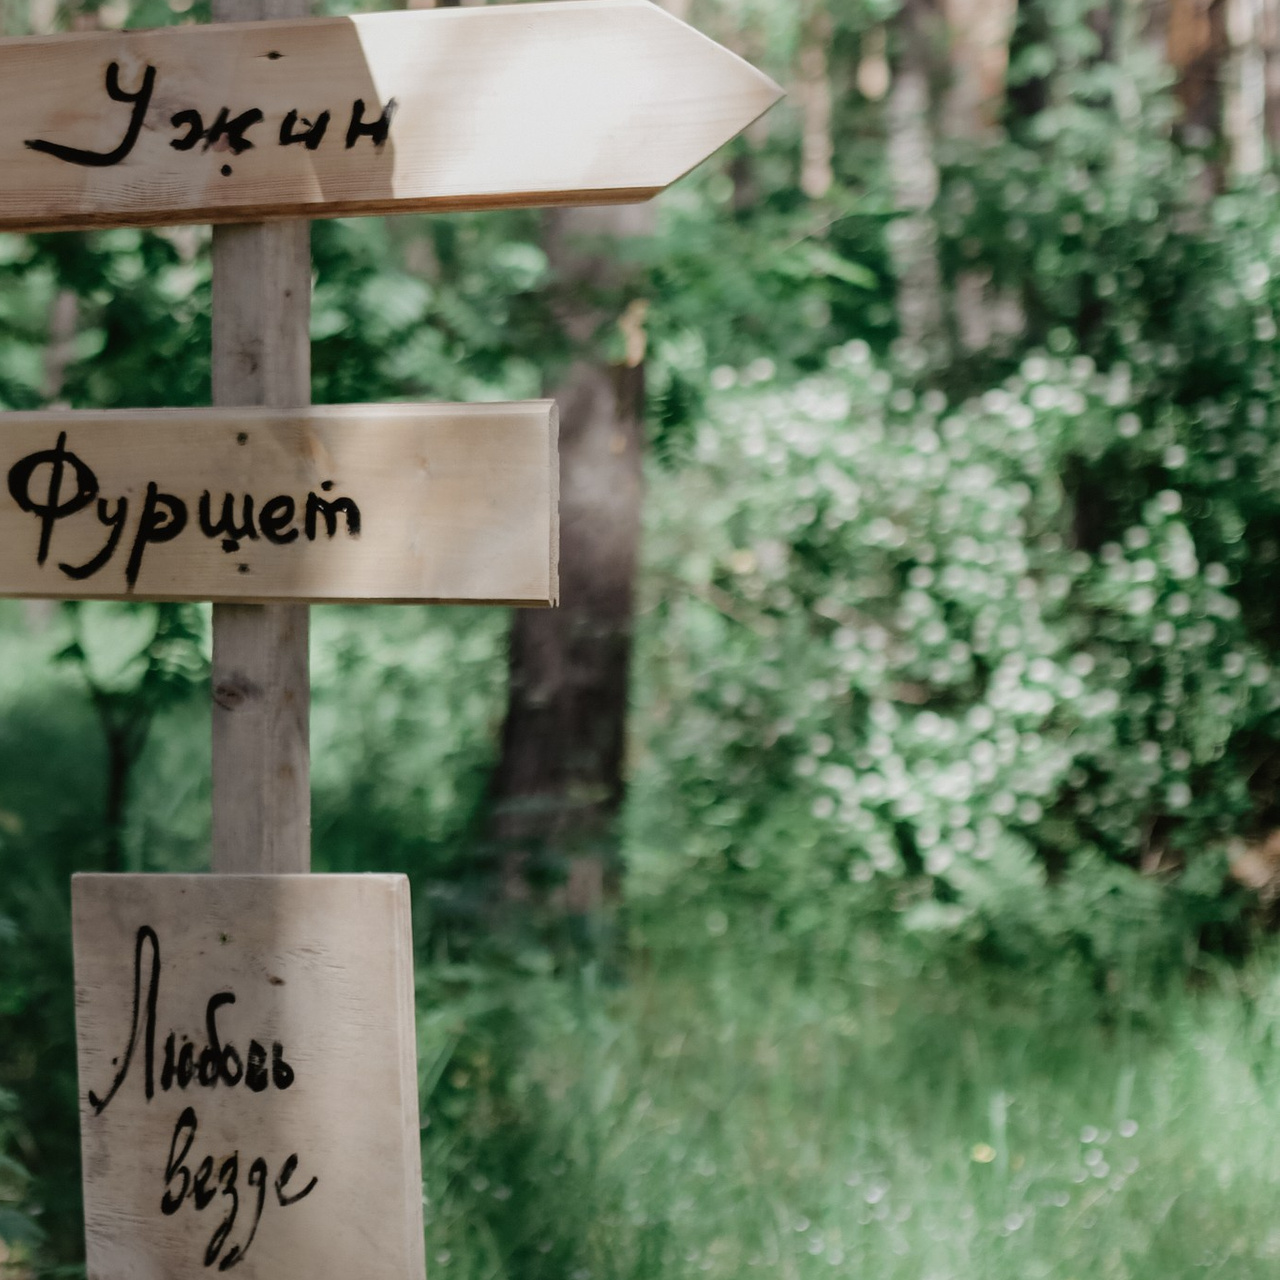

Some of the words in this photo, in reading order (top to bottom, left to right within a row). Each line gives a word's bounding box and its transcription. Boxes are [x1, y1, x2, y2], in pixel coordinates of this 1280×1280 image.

[23, 61, 399, 167] Ужин
[7, 430, 362, 594] Фуршет
[88, 924, 296, 1117] Любовь
